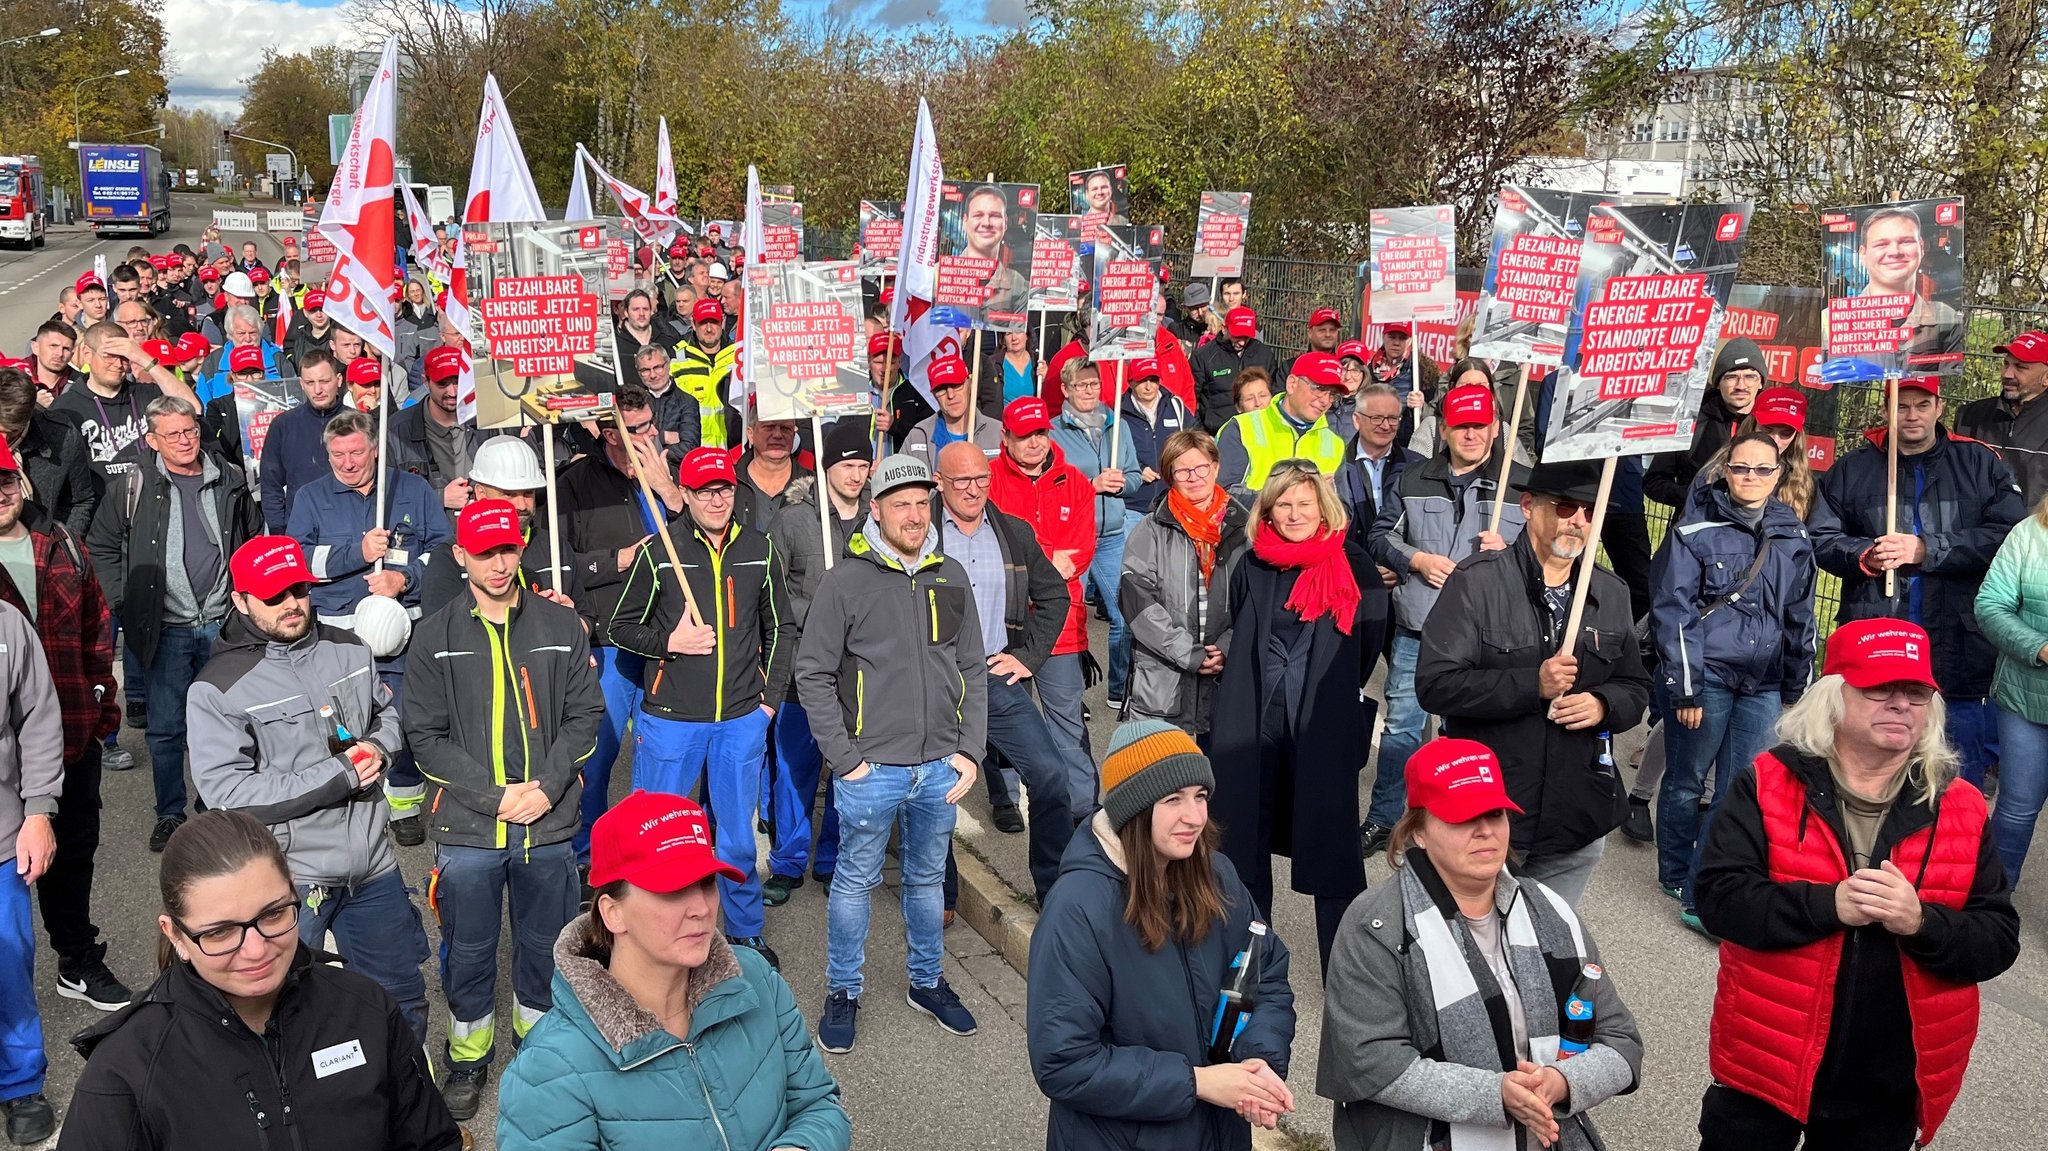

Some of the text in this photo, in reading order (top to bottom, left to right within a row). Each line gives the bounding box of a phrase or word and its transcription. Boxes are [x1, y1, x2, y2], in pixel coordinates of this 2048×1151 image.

[88, 158, 140, 170] LEINSLE
[1389, 237, 1435, 249] BEZAHLBARE
[1047, 251, 1066, 259] JETZT
[1380, 250, 1411, 261] ENERGIE
[1414, 249, 1436, 259] JETZT
[1502, 253, 1547, 270] ENERGIE
[954, 258, 994, 268] BEZAHLBAREN
[1109, 264, 1147, 274] BEZAHLBARE
[1382, 260, 1443, 271] STANDORTE UND
[940, 267, 988, 276] INDUSTRIESTROM
[1384, 270, 1441, 282] ARBEITSPLÄTZE
[940, 275, 976, 286] UND SICHERE
[1102, 276, 1127, 287] ENERGIE
[1128, 275, 1146, 286] JETZT
[1501, 270, 1562, 288] STANDORTE
[499, 279, 578, 298] BEZAHLBARE
[939, 285, 983, 295] ARBEITSPLÄTZE
[1397, 282, 1428, 292] RETTEN!
[1609, 278, 1699, 301] BEZAHLBARE
[1102, 289, 1151, 300] STANDORTE UND
[486, 300, 539, 318] ENERGIE
[543, 298, 580, 315] JETZT
[1103, 301, 1148, 312] ARBEITSPLÄTZE
[1832, 296, 1910, 310] FÜR BEZAHLBAREN
[775, 304, 839, 318] BEZAHLBARE
[1516, 305, 1560, 321] RETTEN!
[1588, 304, 1646, 326] ENERGIE
[1651, 303, 1692, 323] JETZT
[1832, 308, 1904, 320] INDUSTRIESTROM
[490, 316, 592, 337] STANDORTE UND
[765, 320, 806, 333] ENERGIE
[811, 319, 840, 331] JETZT
[1113, 315, 1137, 325] RETTEN!
[1722, 311, 1777, 336] PROJEKT
[1832, 320, 1887, 332] UND SICHERE
[768, 333, 850, 348] STANDORTE UND
[1587, 327, 1666, 350] STANDORTE
[1670, 326, 1699, 345] UND
[1832, 329, 1909, 343] ARBEITSPLÄTZE IN
[495, 335, 590, 356] ARBEITSPLÄTZE
[1832, 342, 1894, 354] DEUTSCHLAND.
[772, 346, 849, 362] ARBEITSPLÄTZE
[1585, 348, 1691, 374] ARBEITSPLÄTZE
[518, 356, 569, 374] RETTEN!
[791, 363, 832, 377] RETTEN!
[1604, 374, 1661, 396] RETTEN!
[884, 465, 926, 483] AUGSBURG
[1878, 630, 1907, 638] wehren
[1451, 755, 1478, 766] wehren
[660, 809, 690, 823] wehren
[320, 1052, 354, 1068] CLARIANT
